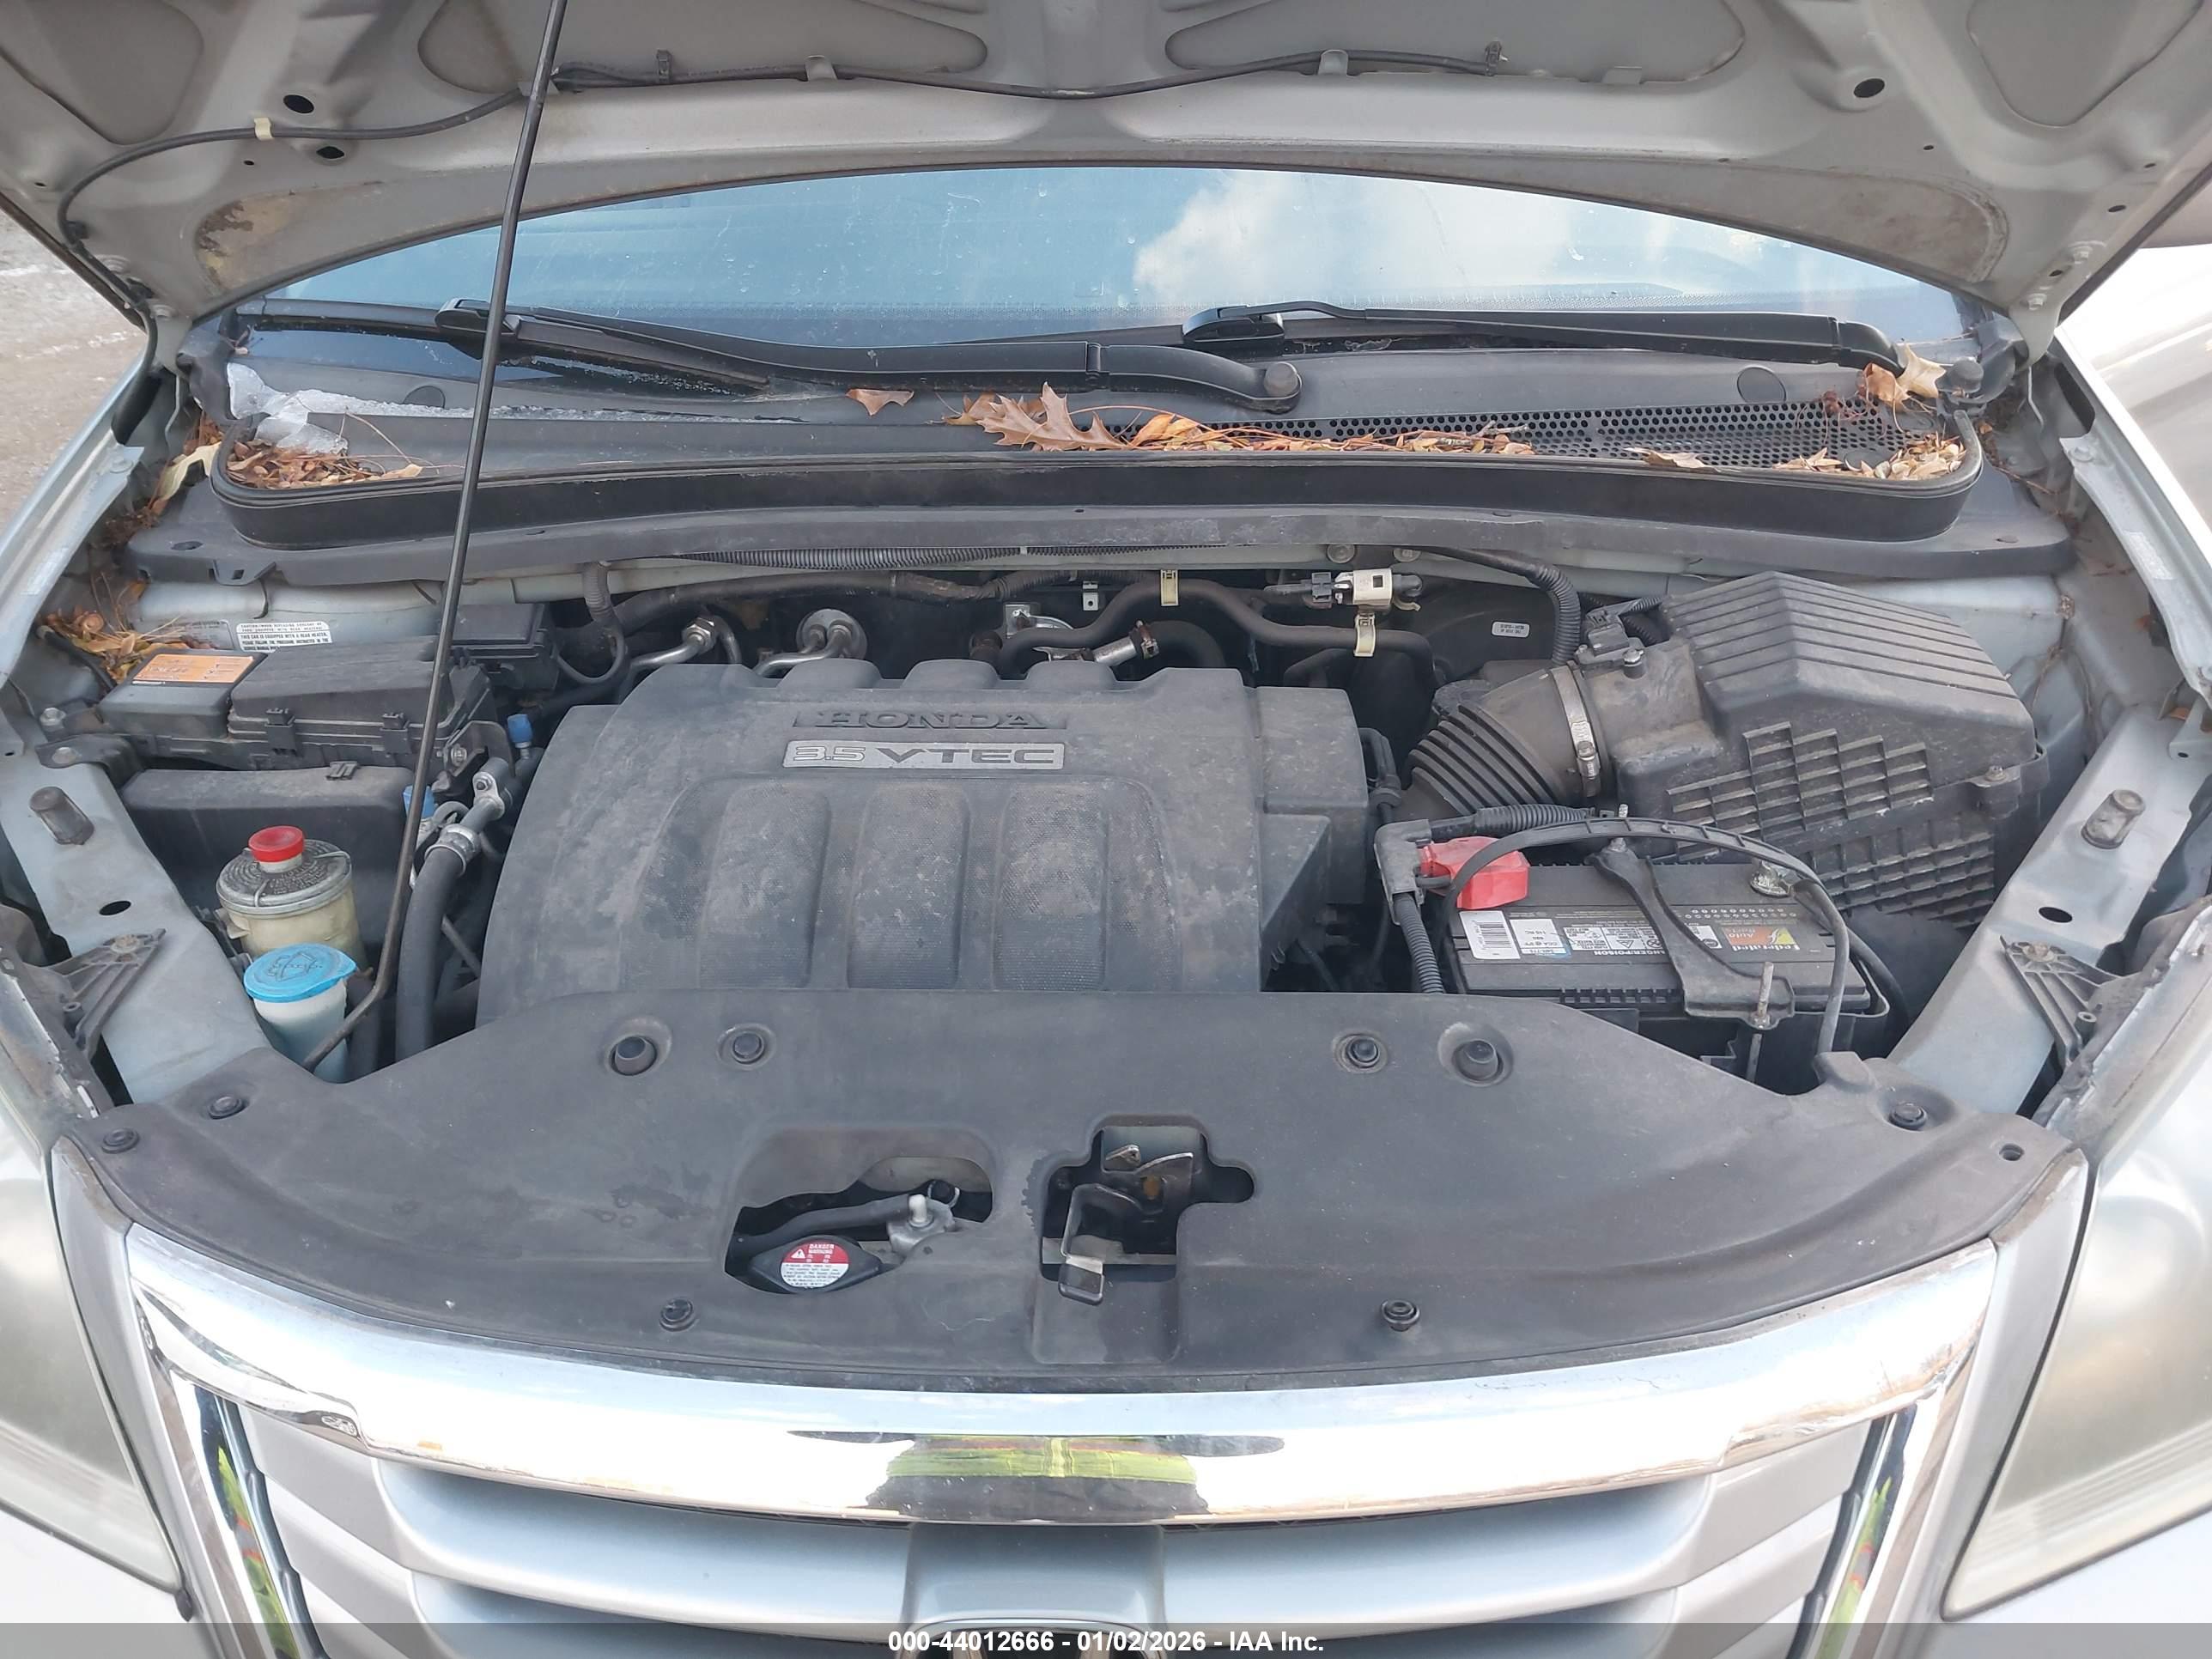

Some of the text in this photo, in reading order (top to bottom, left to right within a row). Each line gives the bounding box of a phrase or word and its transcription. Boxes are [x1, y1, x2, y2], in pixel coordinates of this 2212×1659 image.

[816, 711, 1047, 729] HONDA
[793, 745, 1054, 764] 3.5 VTEC
